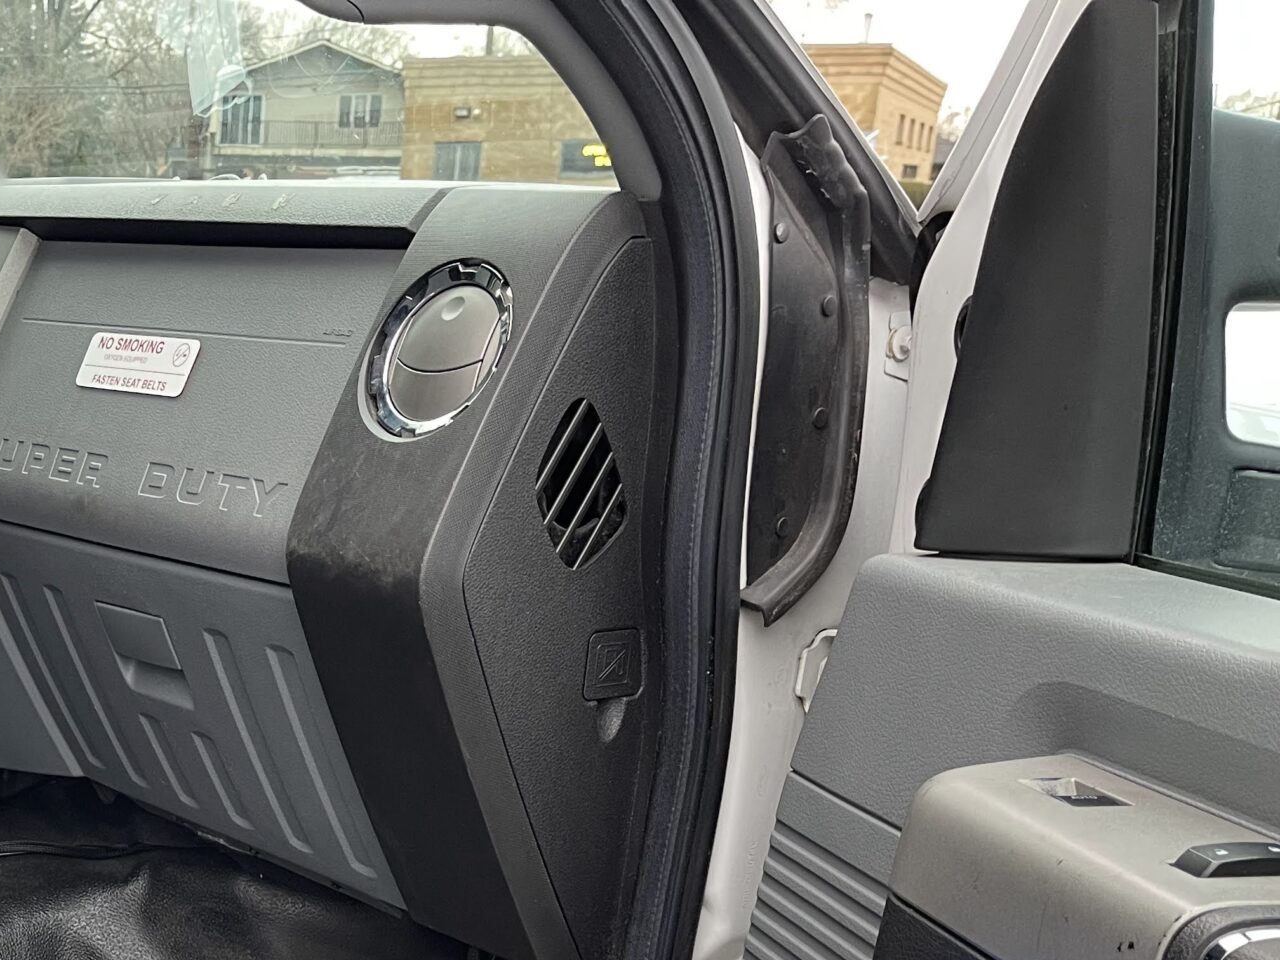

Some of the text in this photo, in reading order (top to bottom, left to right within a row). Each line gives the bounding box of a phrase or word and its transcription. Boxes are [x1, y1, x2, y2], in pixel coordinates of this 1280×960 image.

[98, 336, 166, 354] NO SMOKING
[91, 374, 167, 391] FASTEN SEAT BELTS
[138, 462, 288, 518] DUTY
